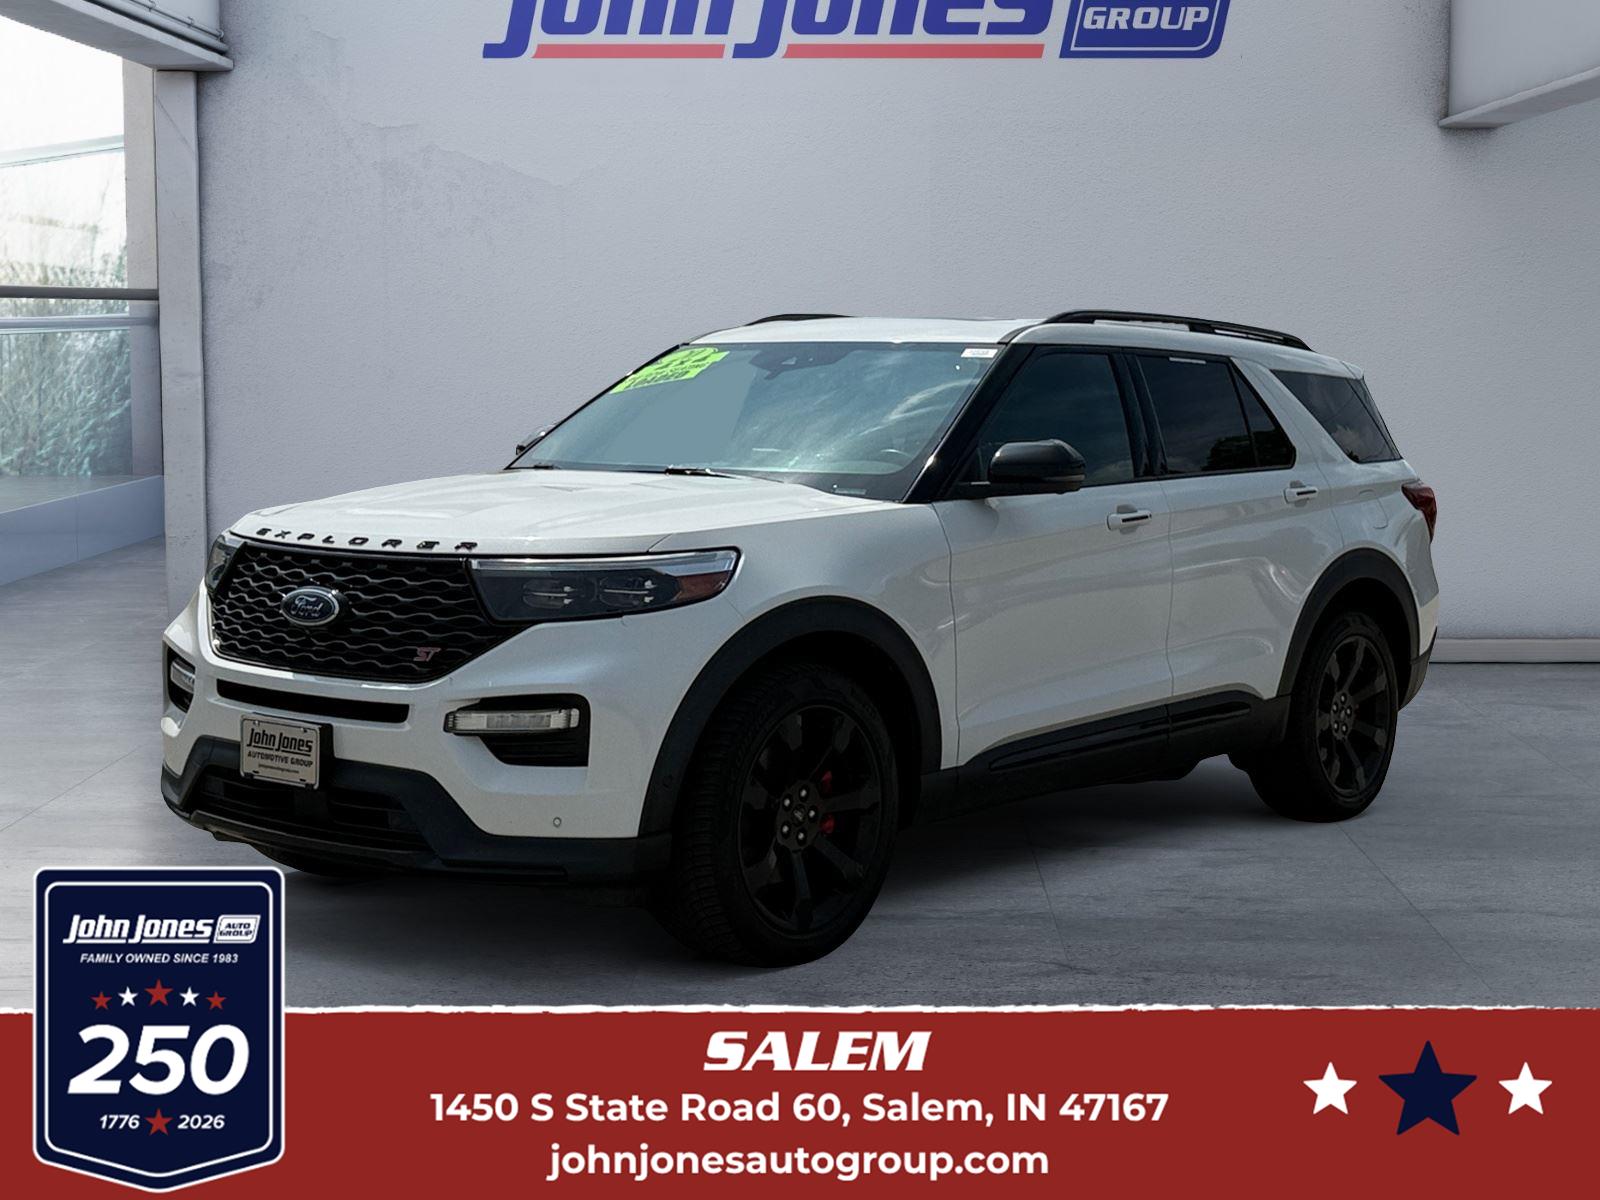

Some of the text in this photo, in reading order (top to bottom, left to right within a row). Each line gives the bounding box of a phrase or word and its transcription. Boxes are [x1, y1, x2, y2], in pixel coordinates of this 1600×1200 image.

[1082, 6, 1210, 31] GROUP
[255, 527, 479, 551] EXPLORER
[413, 646, 441, 662] ST
[246, 727, 314, 754] John Jones
[247, 750, 314, 768] AUTOMOTIVE GROUP
